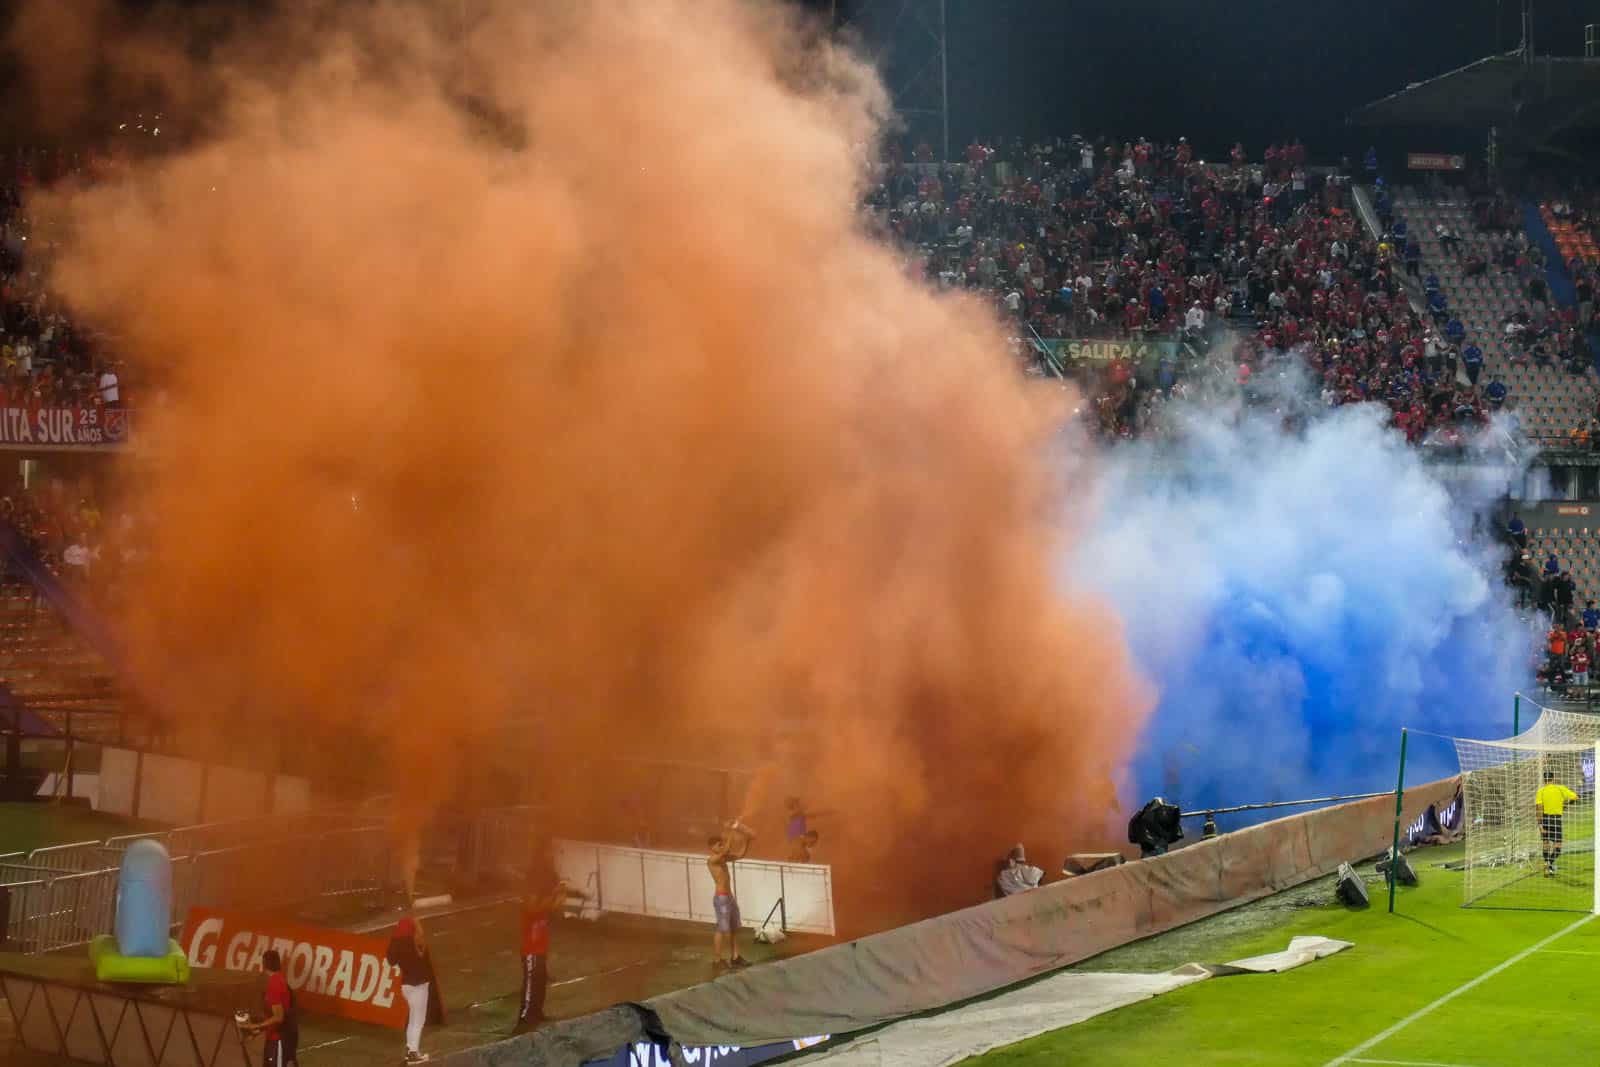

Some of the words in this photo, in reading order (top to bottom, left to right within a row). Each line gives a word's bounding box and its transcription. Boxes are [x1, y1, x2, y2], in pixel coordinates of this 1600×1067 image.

[1068, 342, 1132, 359] SALIDA
[0, 407, 33, 442] ITA
[37, 408, 75, 442] SUR
[79, 409, 97, 424] 25
[77, 424, 102, 441] AÑOS
[188, 917, 225, 968] G
[225, 931, 400, 1009] GATORADE
